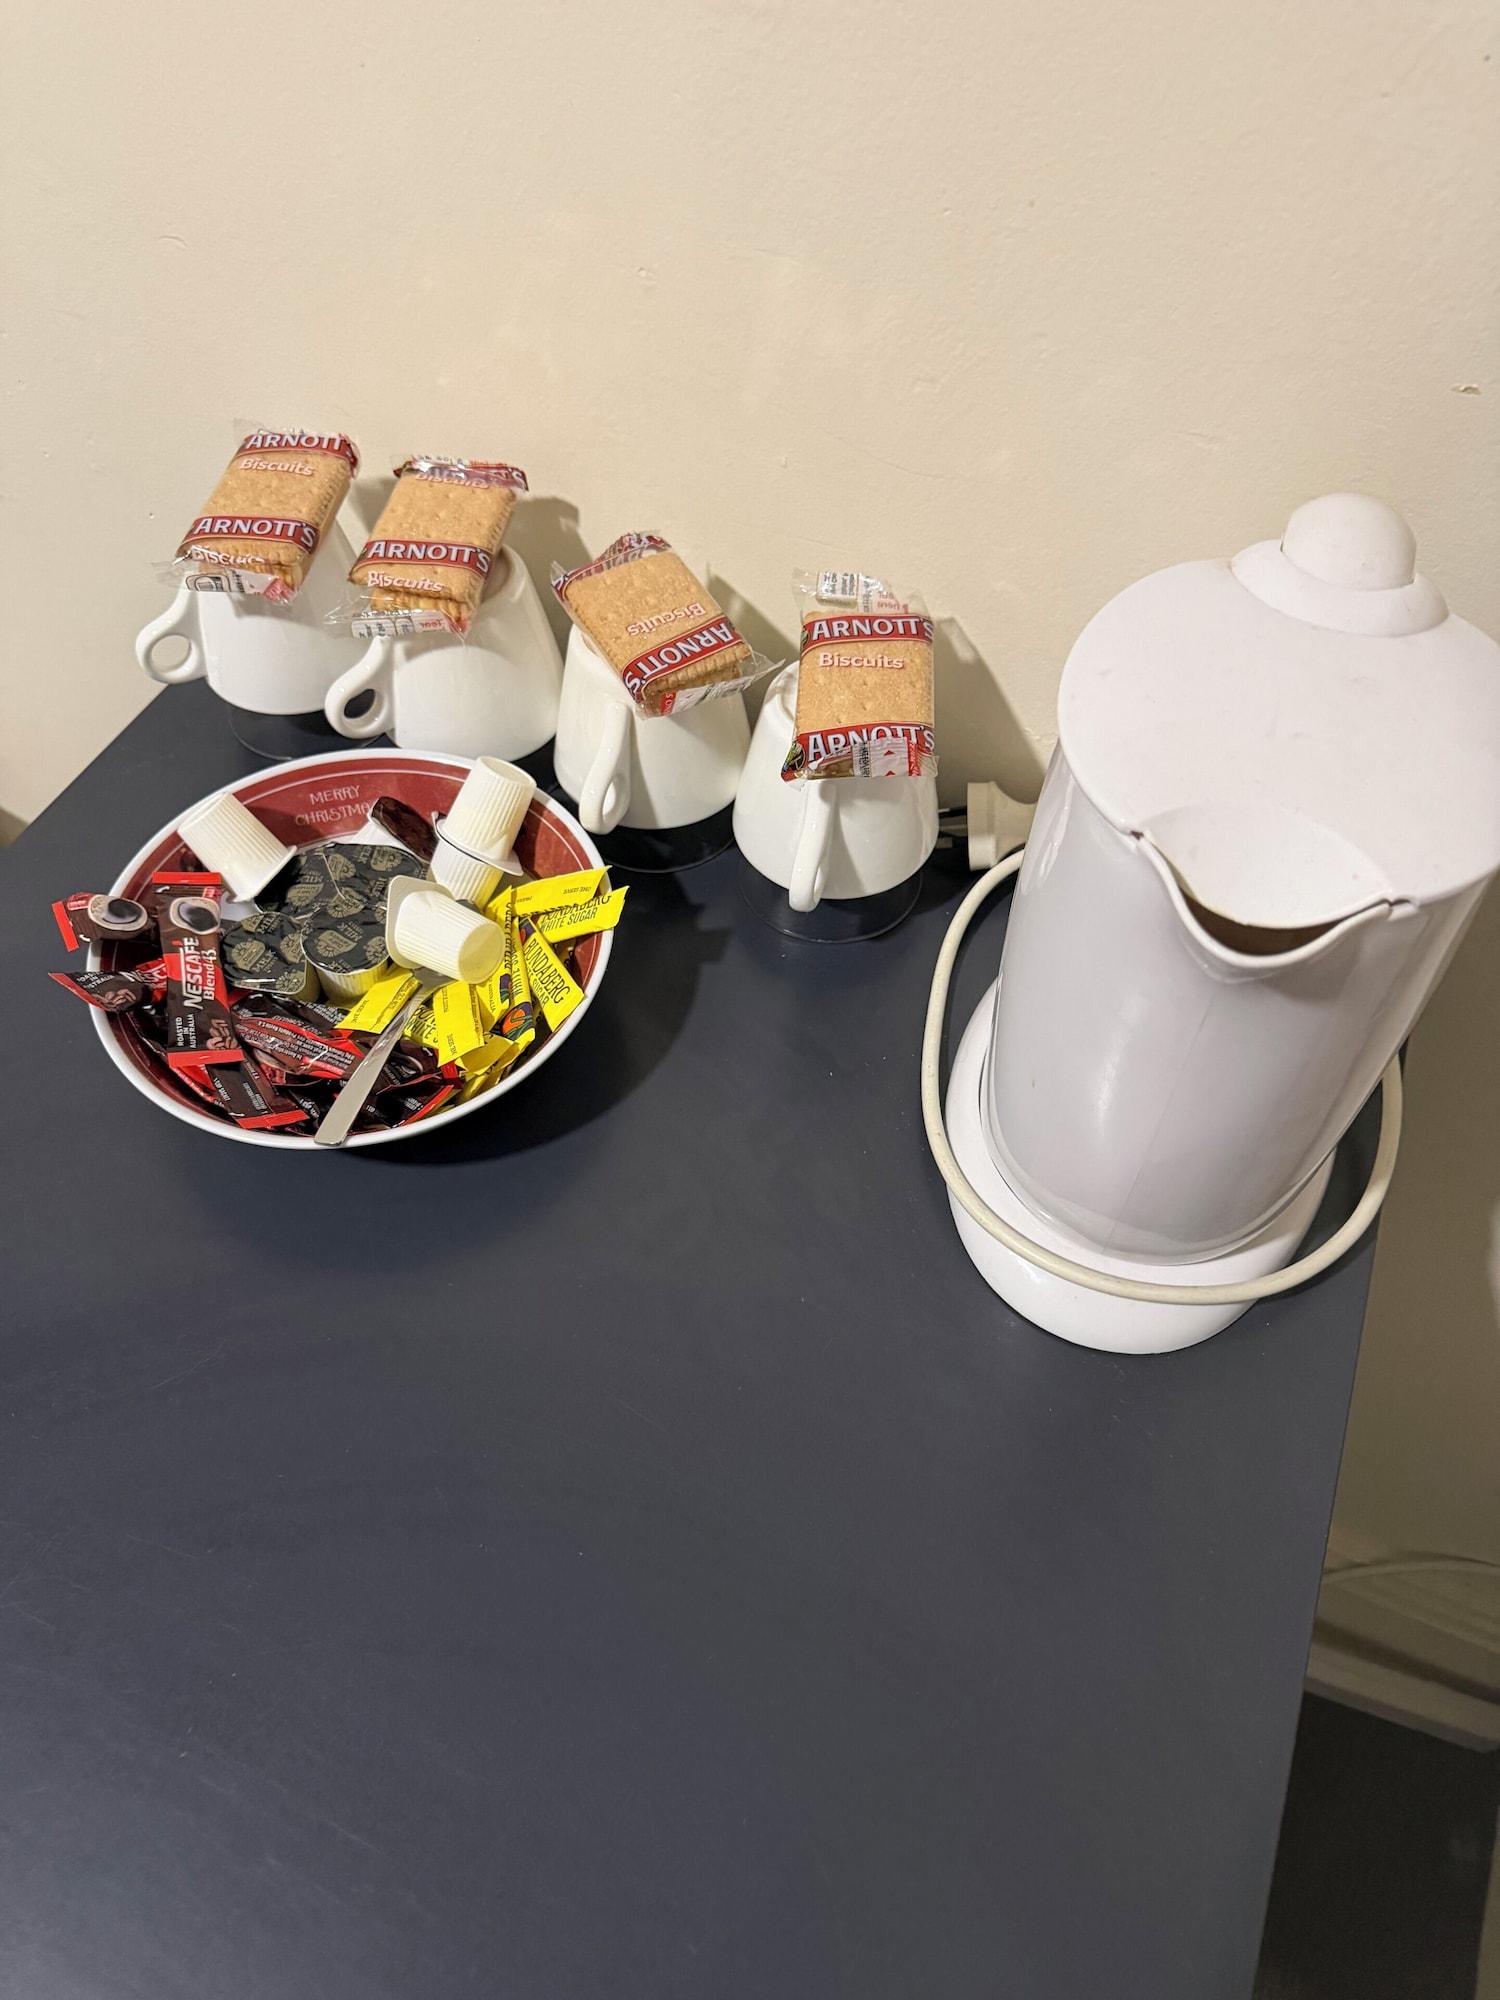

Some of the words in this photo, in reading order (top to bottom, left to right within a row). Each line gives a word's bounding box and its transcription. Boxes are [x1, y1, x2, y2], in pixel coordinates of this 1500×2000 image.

[246, 432, 355, 462] ARNOTT'
[239, 458, 315, 476] Biscuits
[194, 517, 317, 547] ARNOTT'S
[367, 540, 491, 574] ARNOTT'S
[367, 571, 445, 592] Biscuits
[626, 602, 706, 637] Biscuits
[811, 616, 935, 642] ARNOTT'S
[625, 621, 735, 694] ARNOTT'S
[818, 652, 905, 669] Biscuits
[309, 785, 361, 806] MERRY
[295, 802, 371, 826] CHRISTMA
[567, 906, 598, 925] SUGAR
[523, 937, 571, 1005] BUNDABERG
[175, 1017, 184, 1047] ROASTED
[183, 1027, 189, 1035] IN
[187, 1013, 197, 1049] AUSTRALIA
